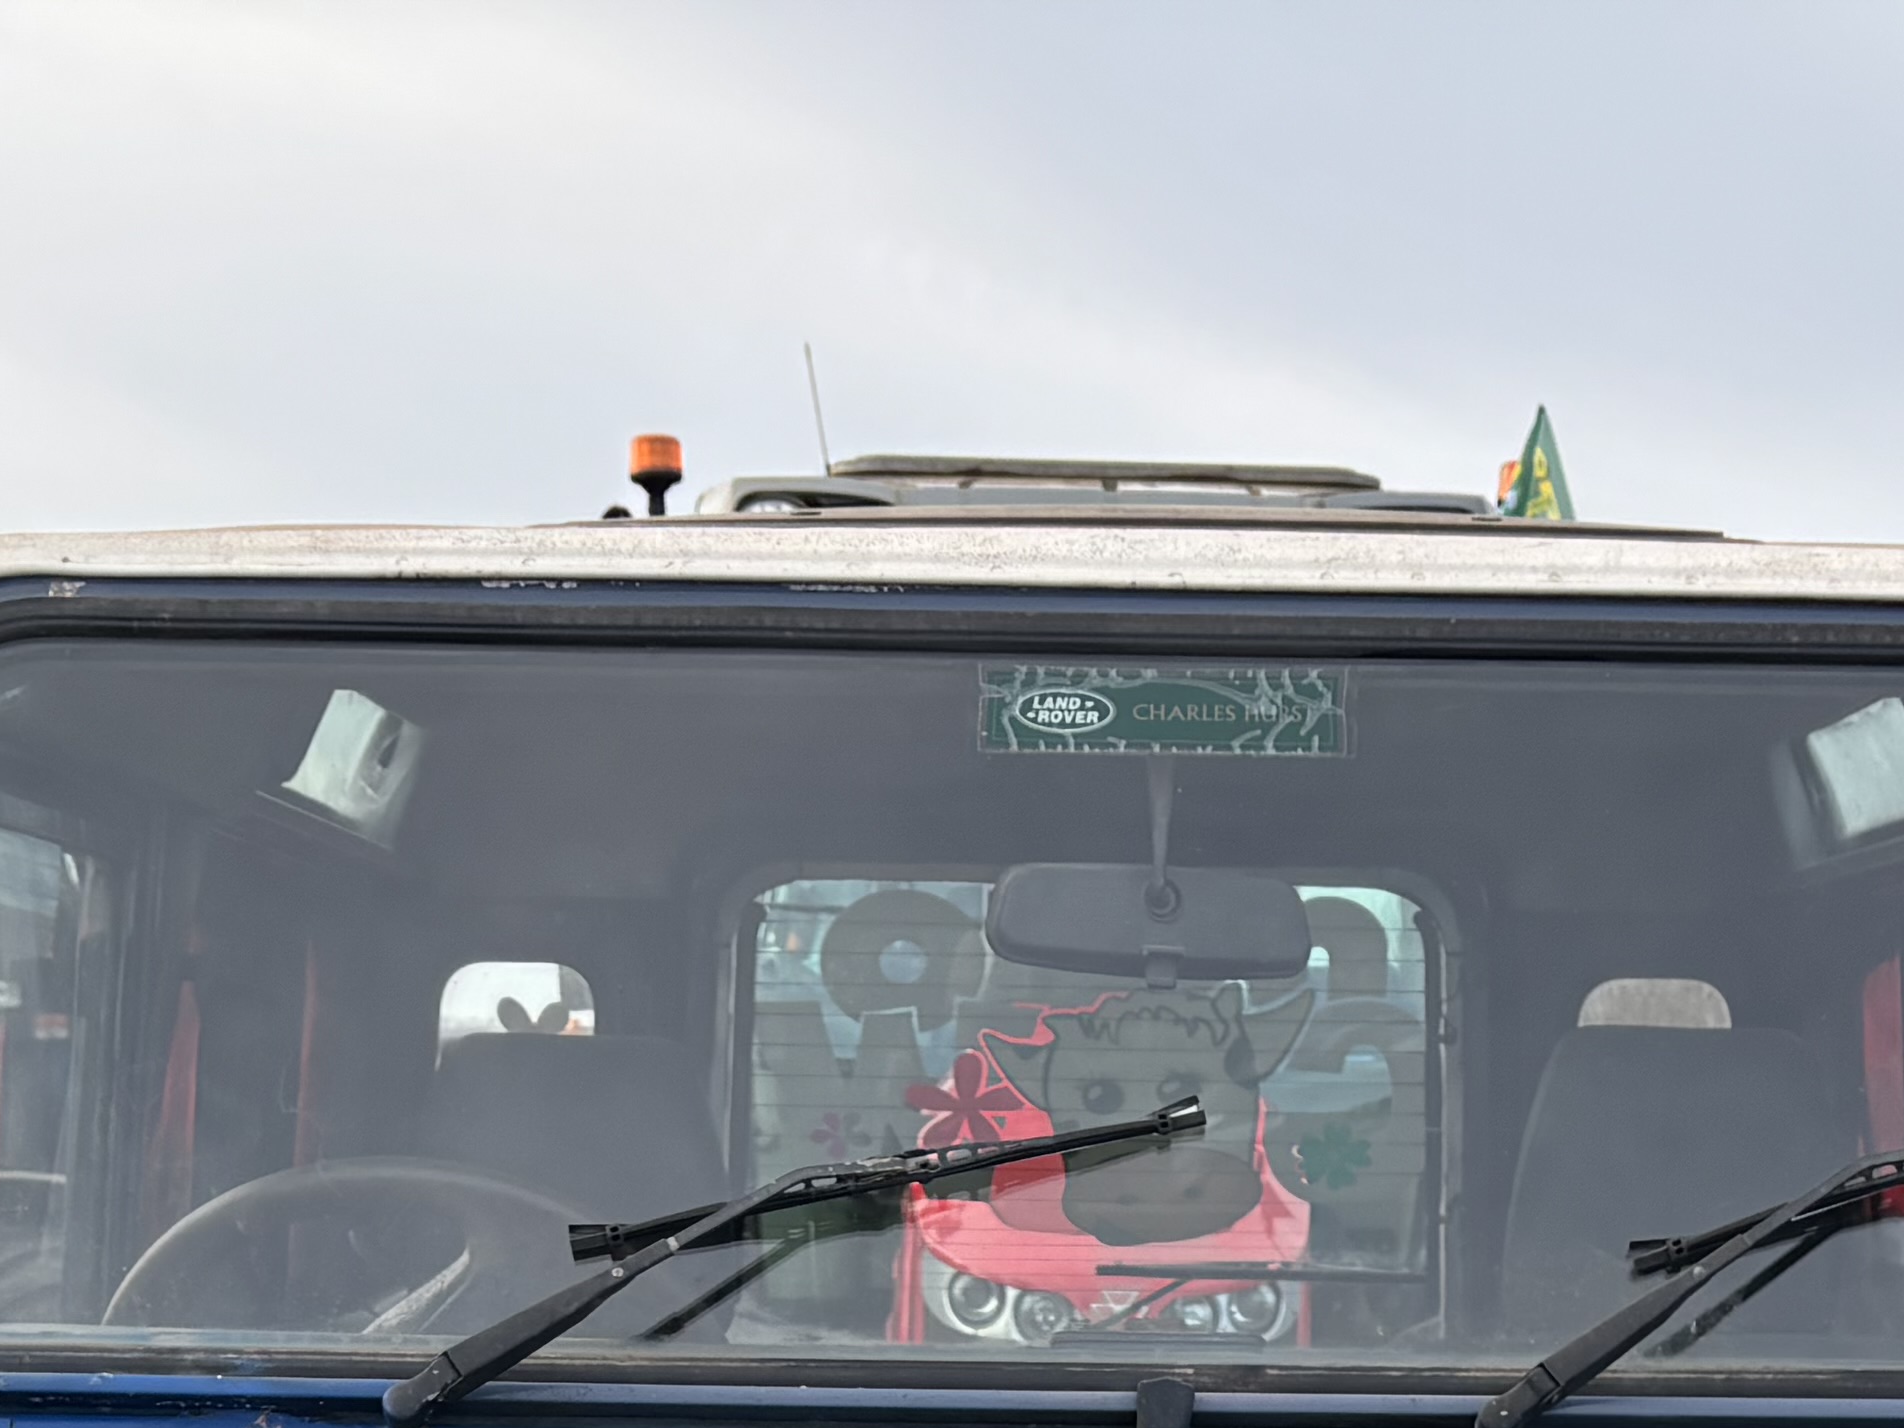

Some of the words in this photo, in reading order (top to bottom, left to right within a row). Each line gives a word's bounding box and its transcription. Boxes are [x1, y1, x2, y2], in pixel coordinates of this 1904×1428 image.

[1032, 696, 1081, 710] LAND
[1037, 710, 1099, 724] ROVER
[1133, 704, 1235, 722] CHARLES
